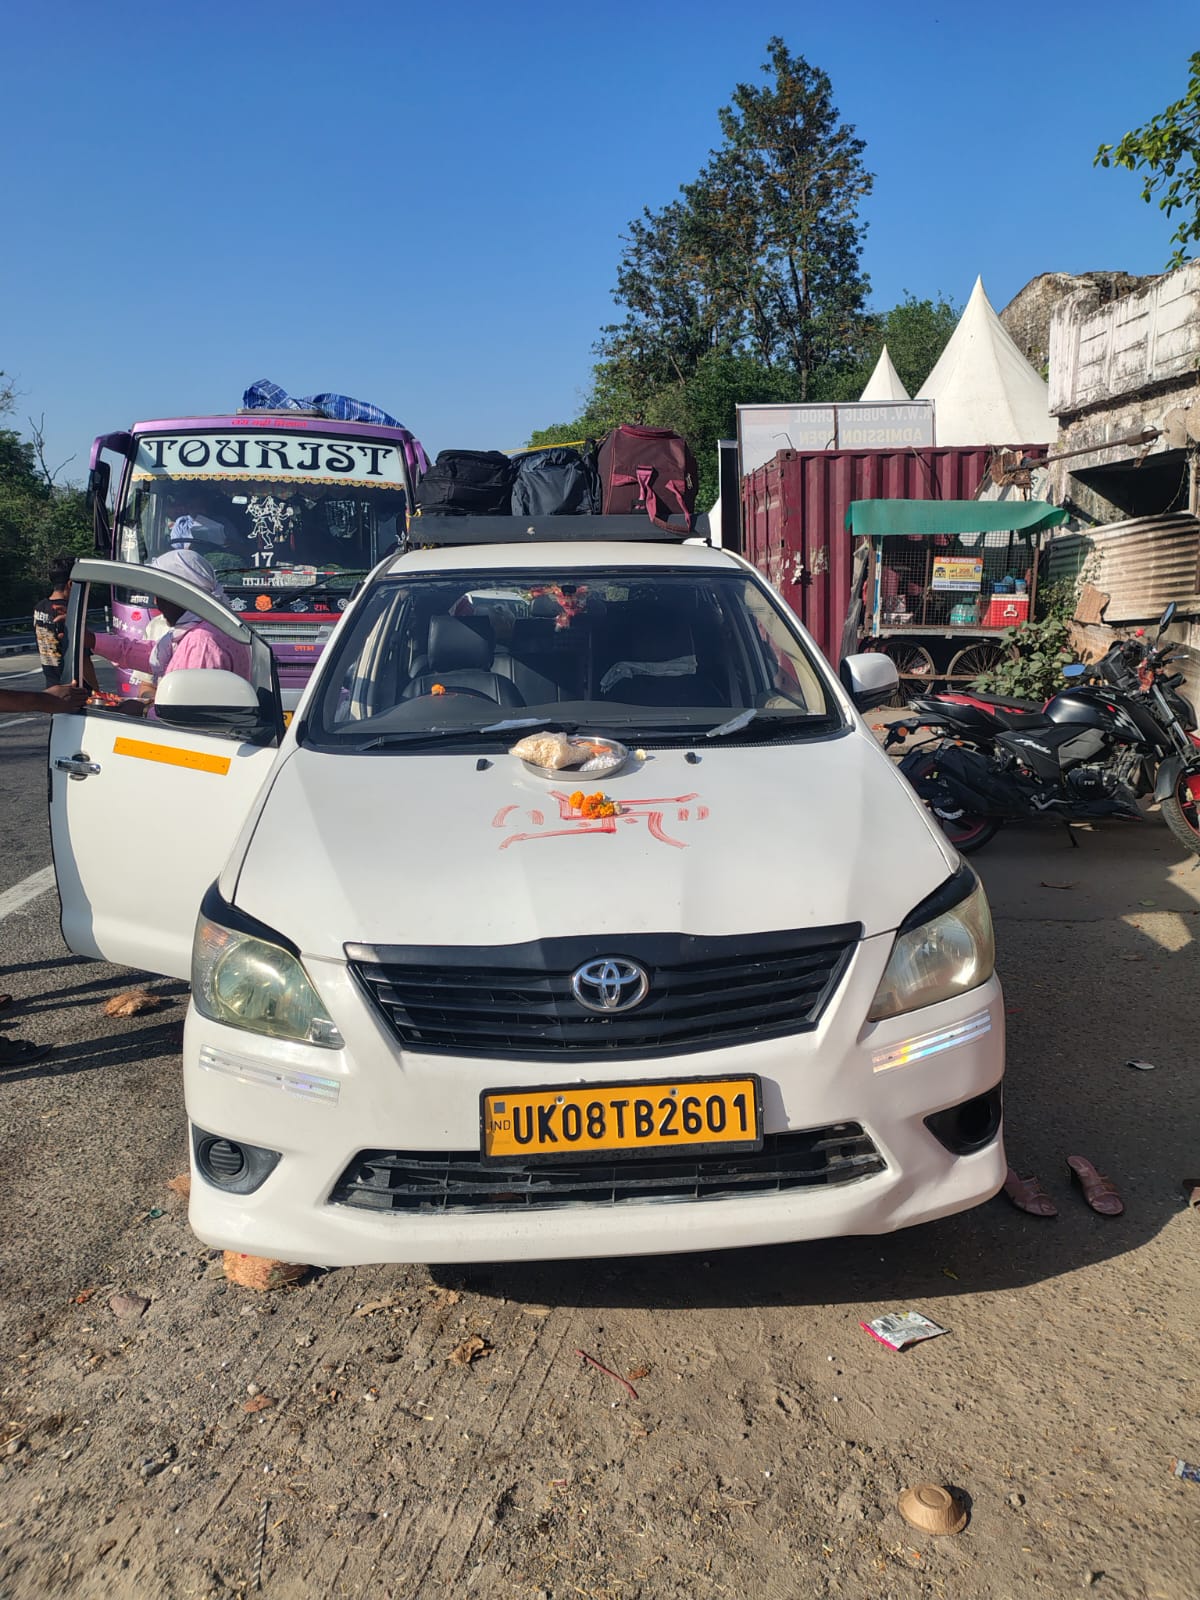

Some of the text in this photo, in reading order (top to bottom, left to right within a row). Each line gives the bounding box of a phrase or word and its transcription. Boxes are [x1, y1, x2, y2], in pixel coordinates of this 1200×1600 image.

[143, 439, 393, 476] TOURIST
[251, 552, 274, 568] 17
[490, 1119, 511, 1131] IND
[512, 1093, 748, 1145] UK08TB2601
